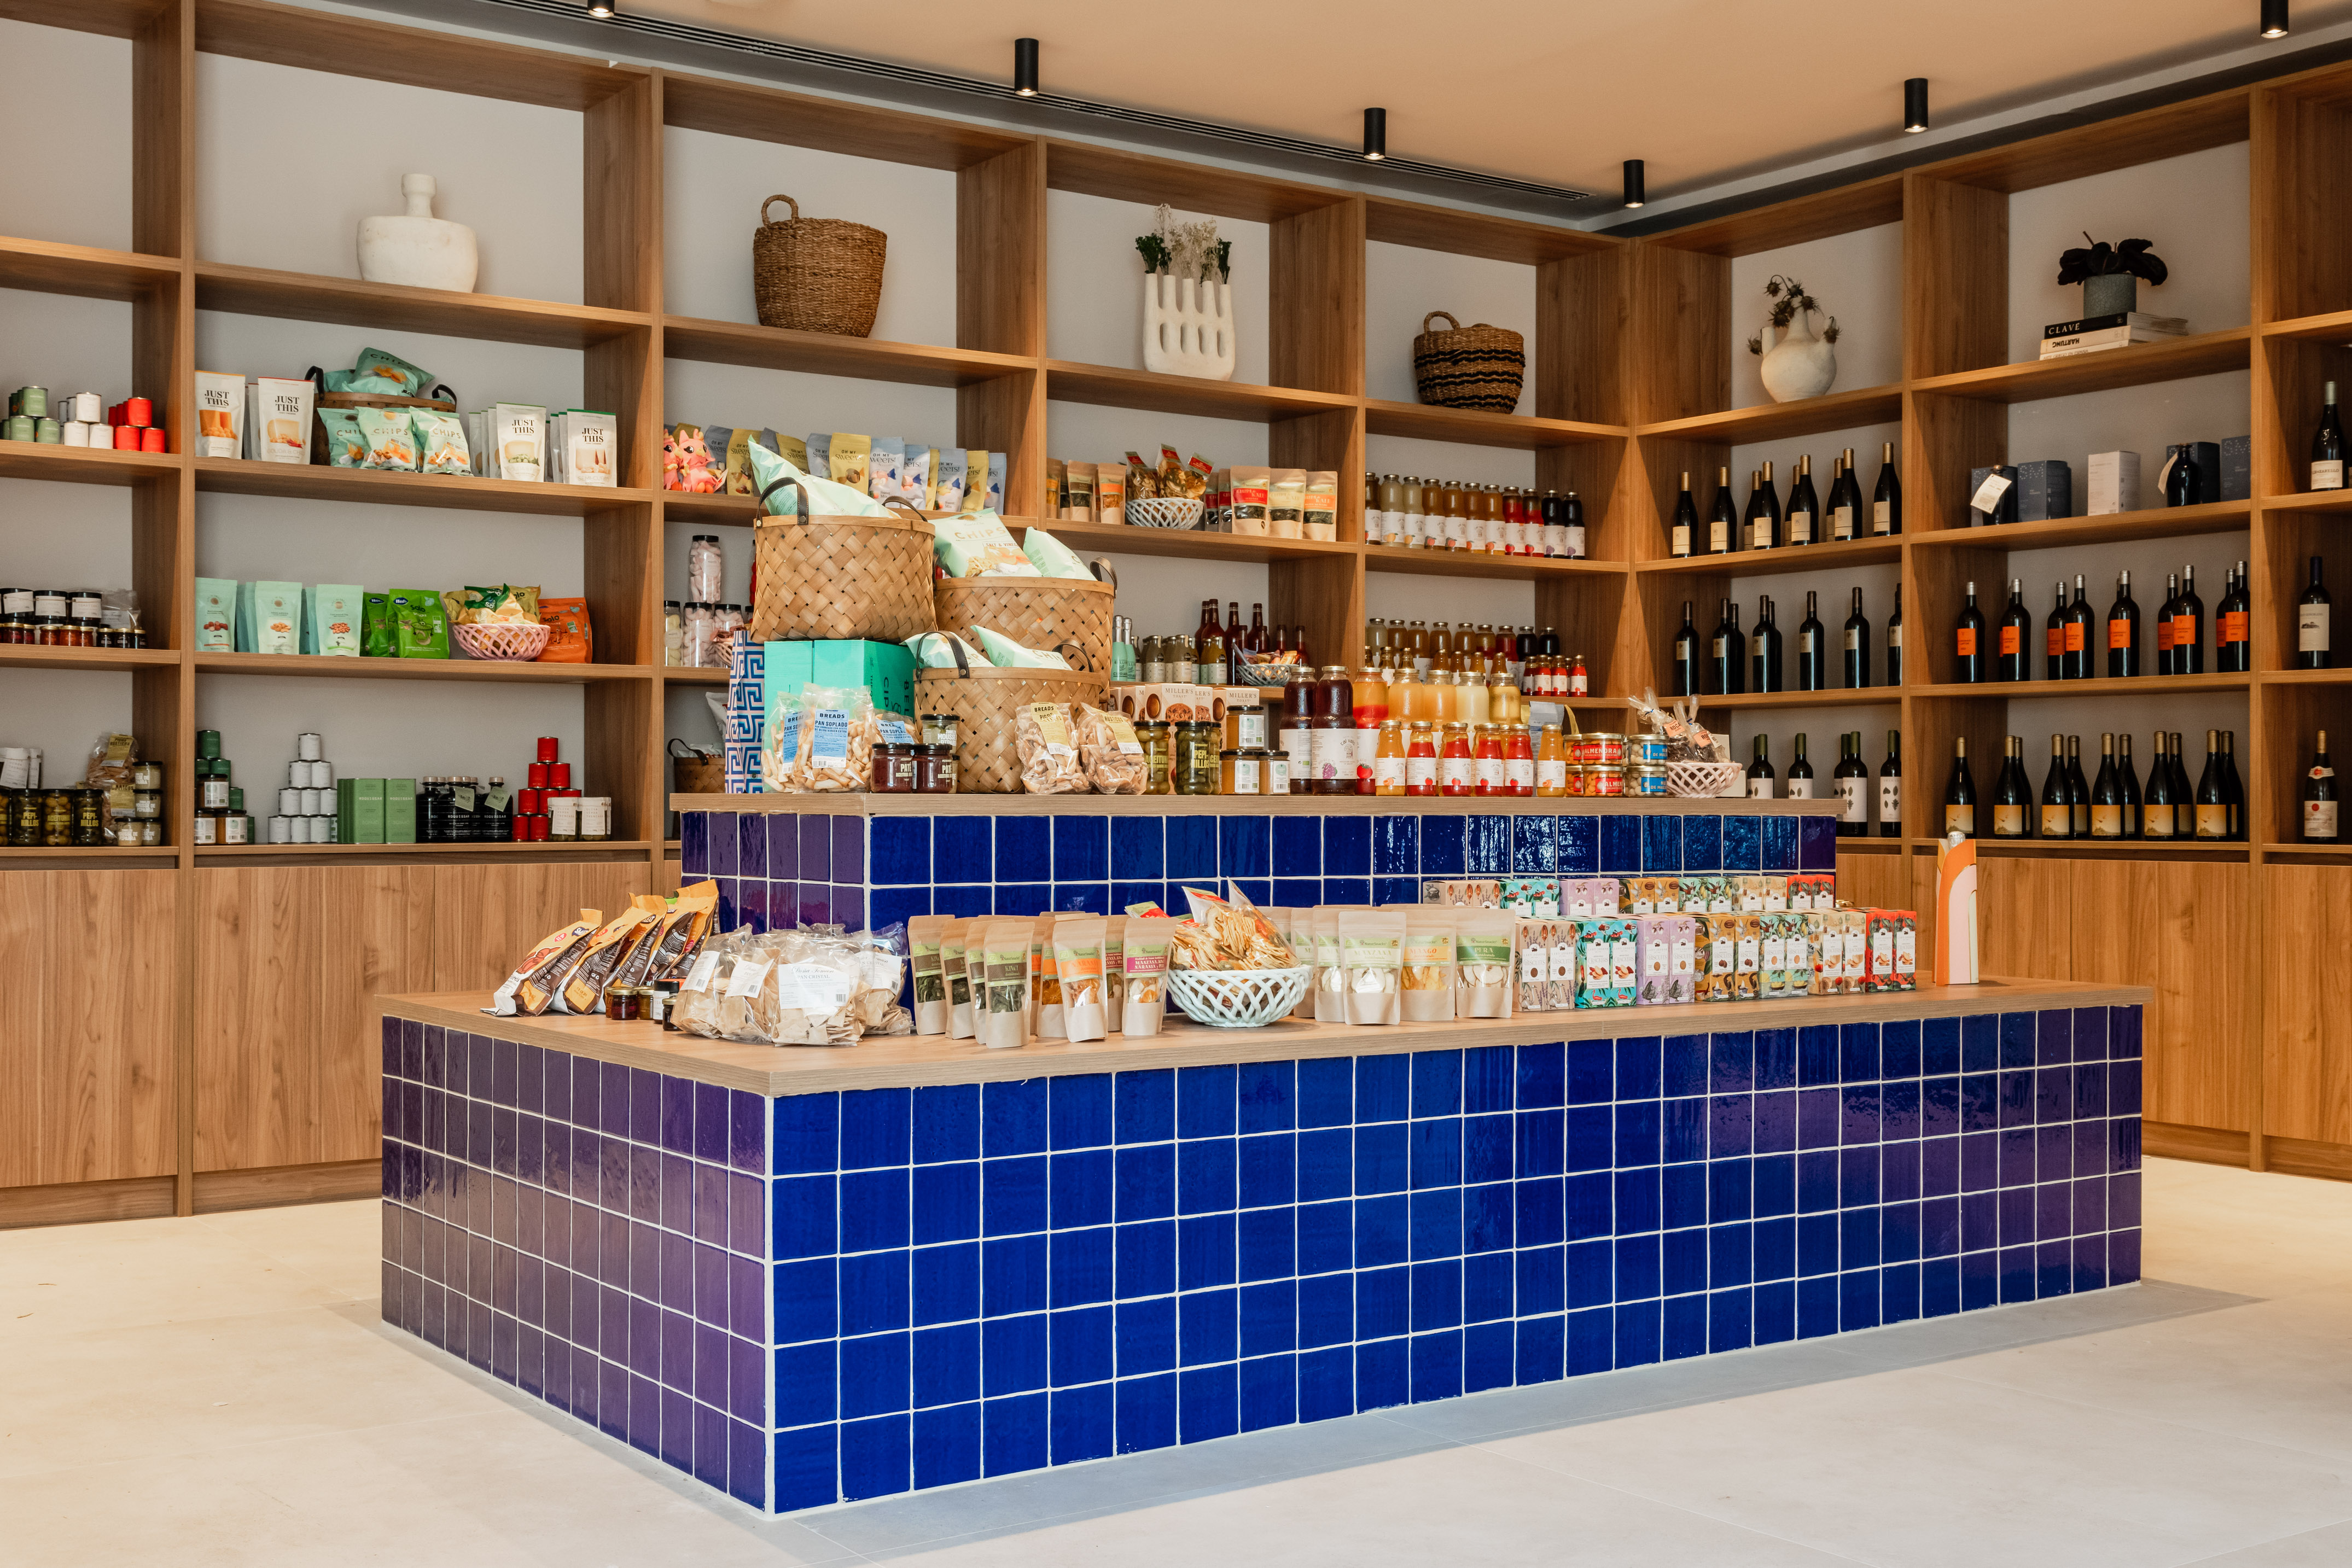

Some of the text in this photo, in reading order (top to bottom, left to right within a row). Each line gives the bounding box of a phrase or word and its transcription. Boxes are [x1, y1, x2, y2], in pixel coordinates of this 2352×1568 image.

[2048, 323, 2080, 335] CLAVE
[2052, 338, 2080, 348] HARTUNG
[205, 390, 229, 399] JUST
[205, 398, 229, 406] THIS
[275, 395, 300, 404] JUST
[275, 404, 299, 412] THIS
[433, 428, 461, 439] CHIPS
[954, 526, 1006, 540] CHIPS
[410, 604, 426, 613] Solo
[1194, 750, 1208, 759] PEPI-
[900, 762, 912, 772] PATÉ
[942, 763, 952, 773] PATÉ
